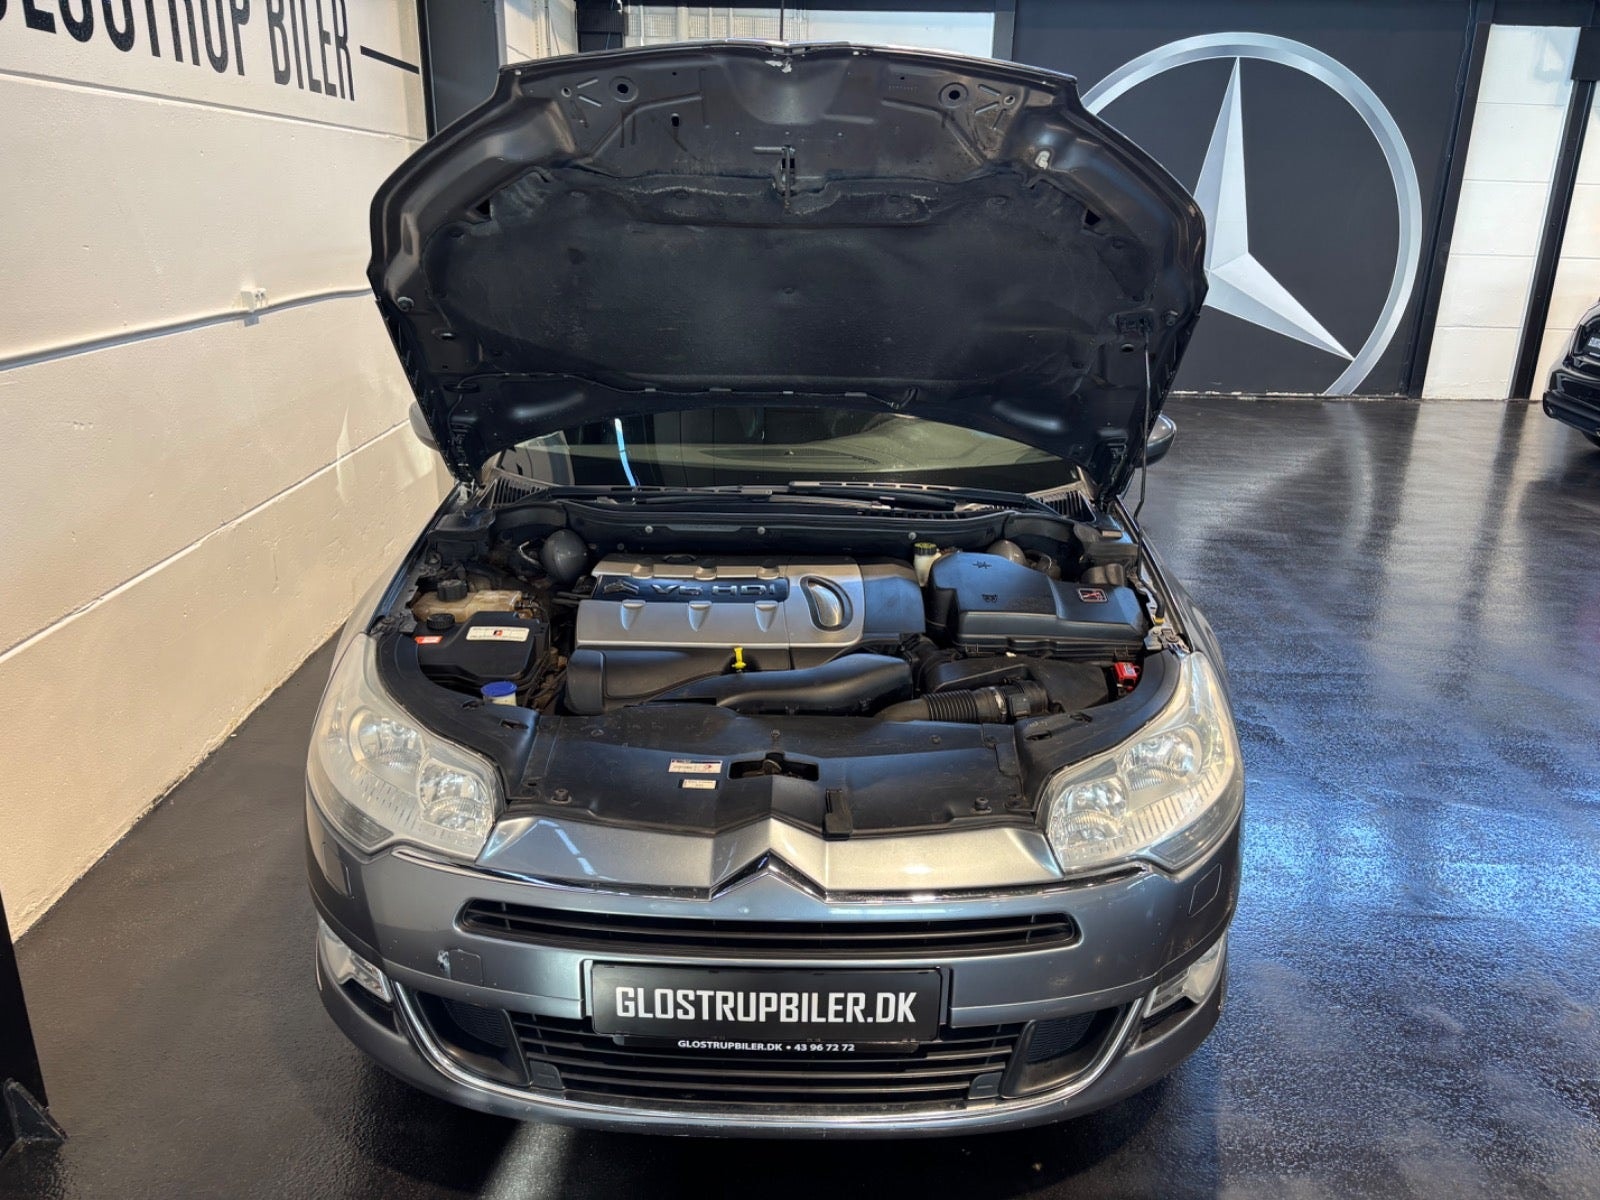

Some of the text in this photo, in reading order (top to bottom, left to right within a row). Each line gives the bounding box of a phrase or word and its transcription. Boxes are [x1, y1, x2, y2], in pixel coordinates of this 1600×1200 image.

[265, 0, 355, 101] BILER
[615, 986, 918, 1024] GLOSTRUPBILER.DK
[677, 1039, 855, 1052] GLOSTRUPBILER.DK 43 96 72 72
